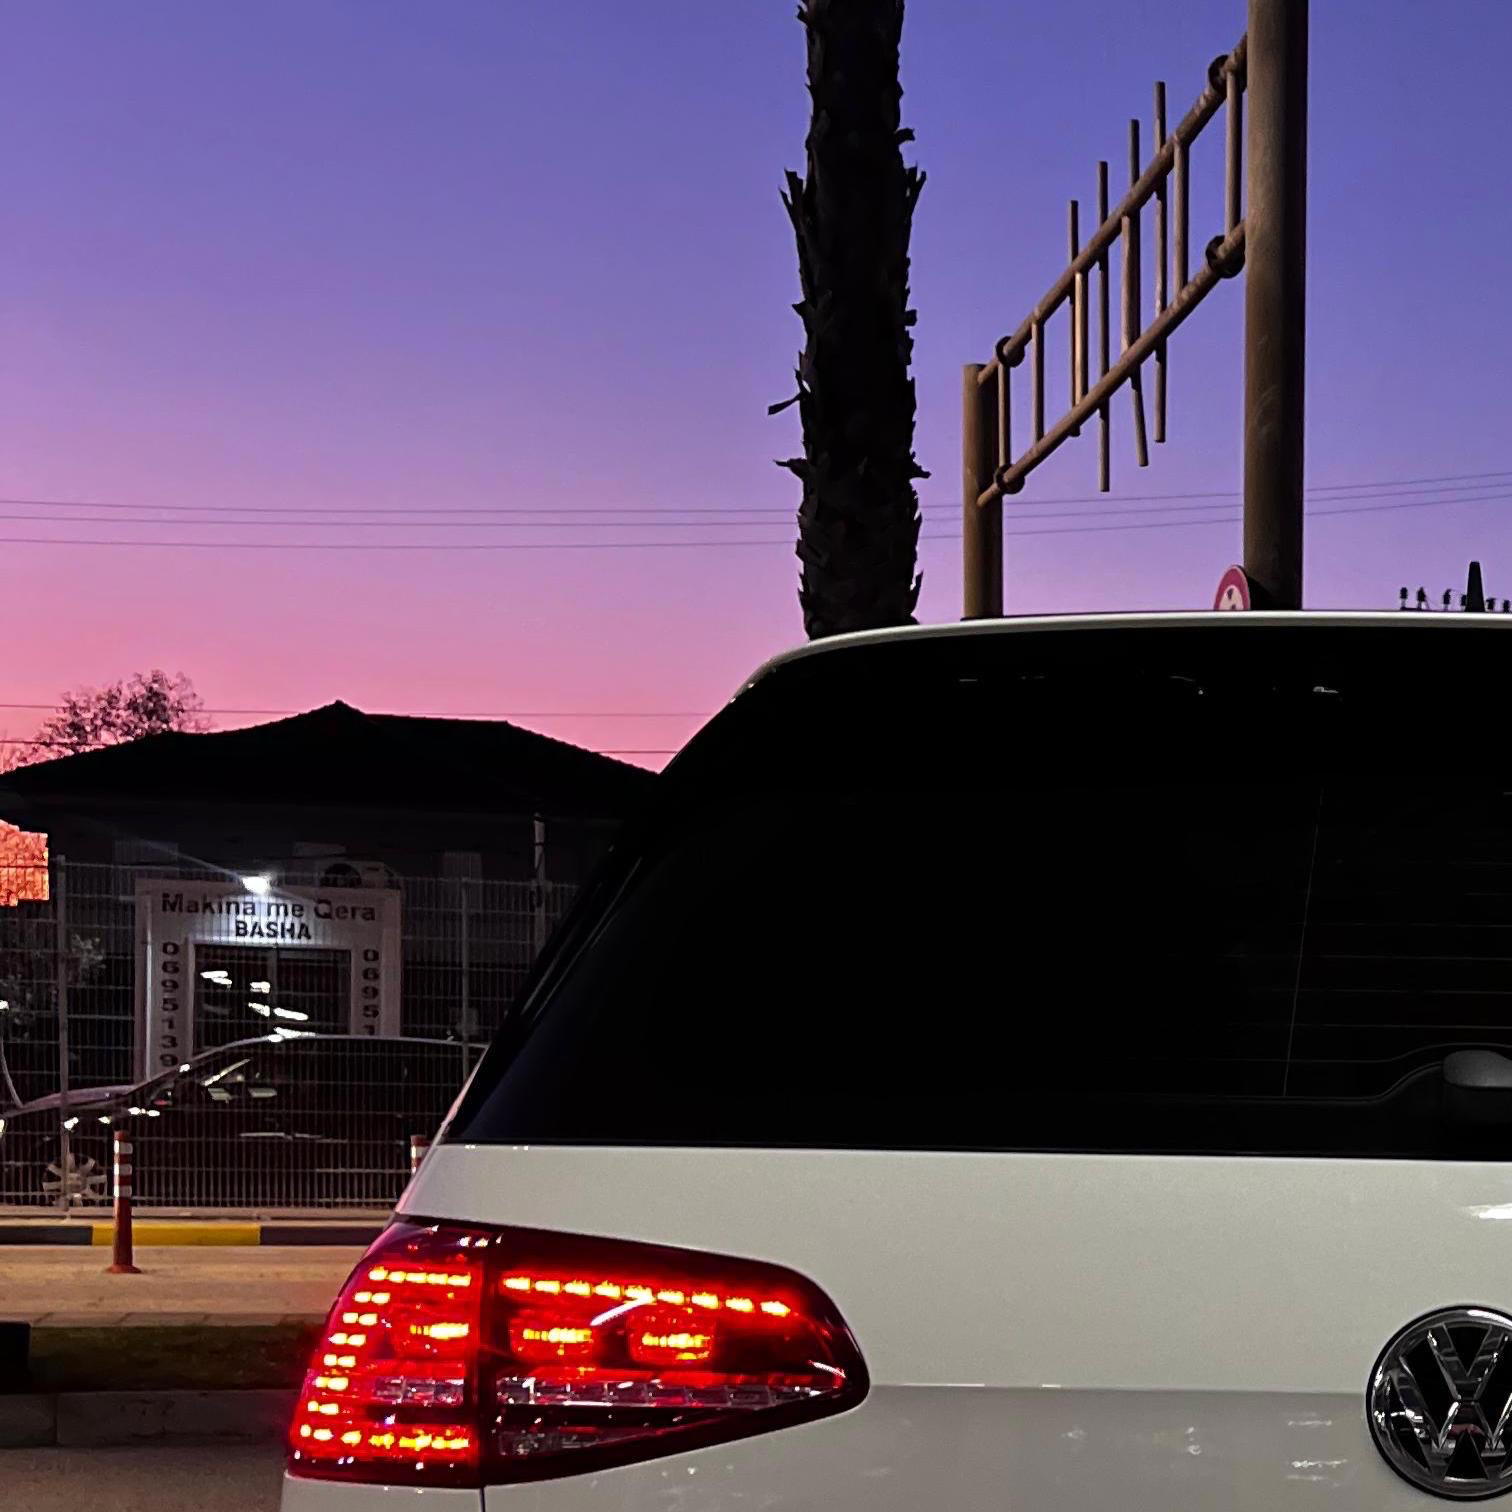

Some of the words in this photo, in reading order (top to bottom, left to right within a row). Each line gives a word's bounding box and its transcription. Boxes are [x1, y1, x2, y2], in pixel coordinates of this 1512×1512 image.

[161, 892, 256, 916] Makina
[266, 901, 304, 918] me
[314, 899, 376, 921] Qera
[235, 920, 312, 940] BASHA
